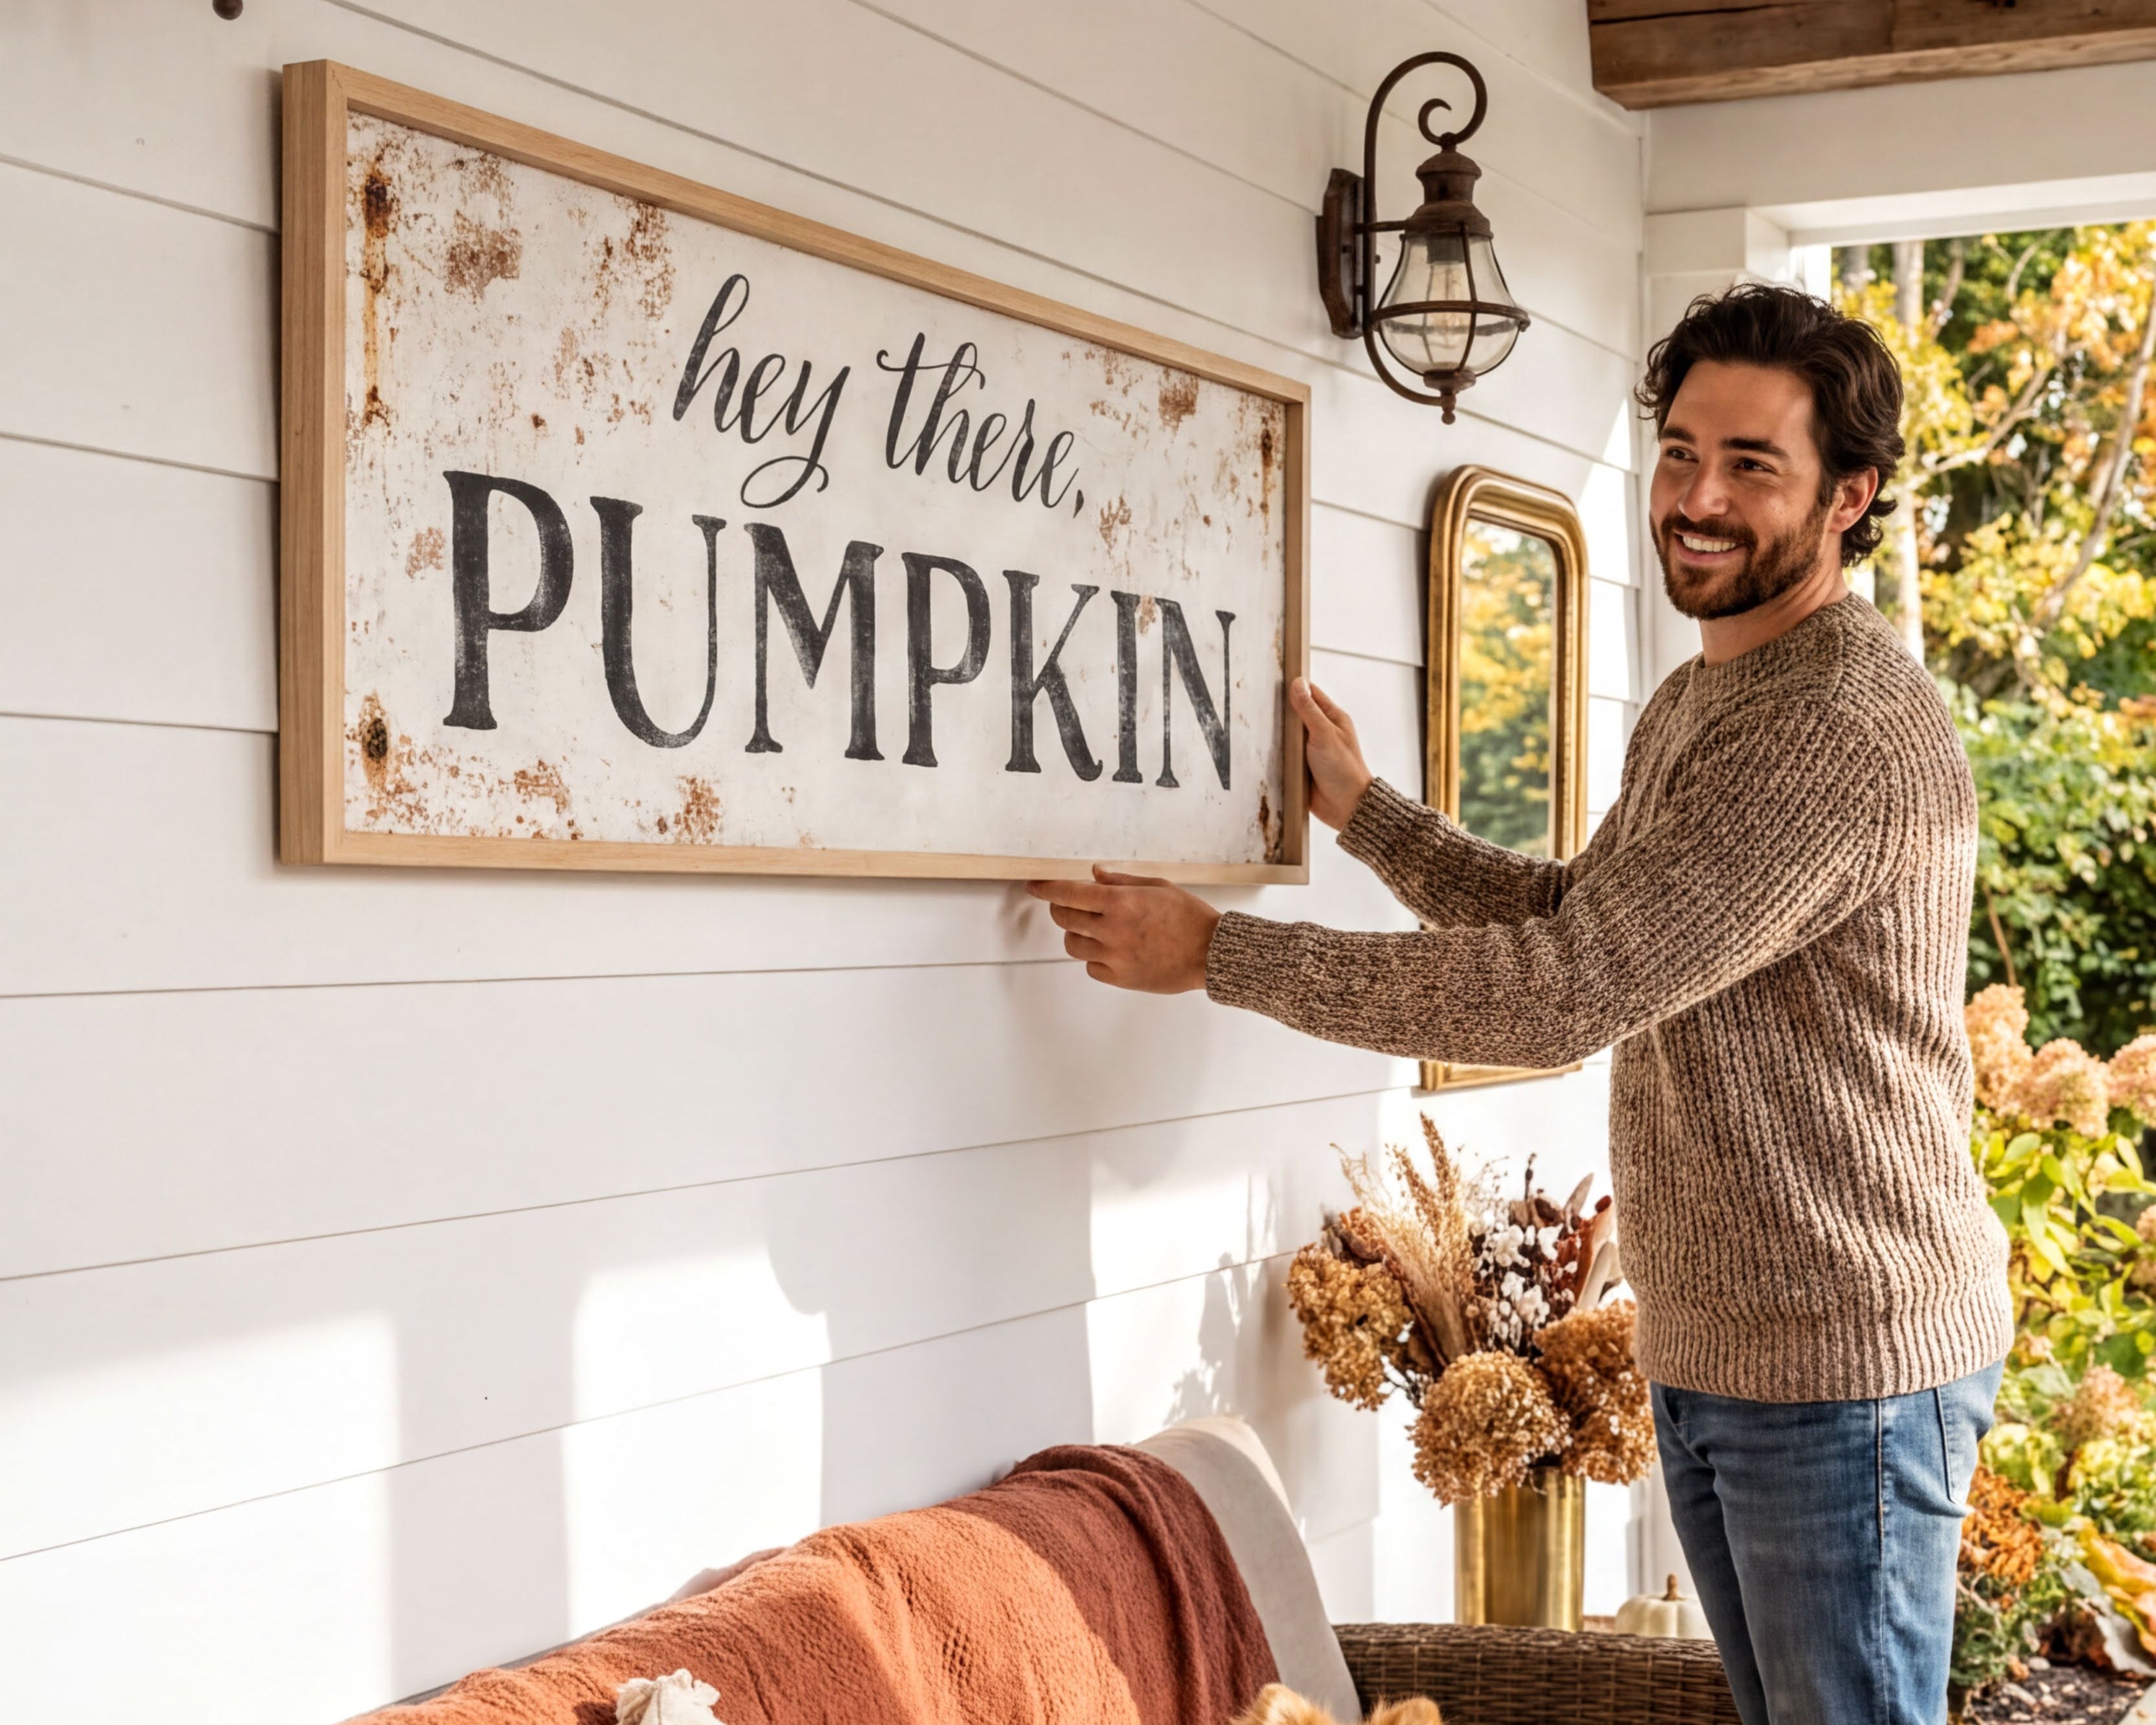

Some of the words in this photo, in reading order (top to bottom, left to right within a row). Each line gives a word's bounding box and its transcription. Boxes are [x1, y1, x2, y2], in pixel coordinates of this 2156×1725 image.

[673, 274, 850, 508] hey
[877, 332, 1084, 518] there,
[443, 470, 1236, 791] PUMPKIN
